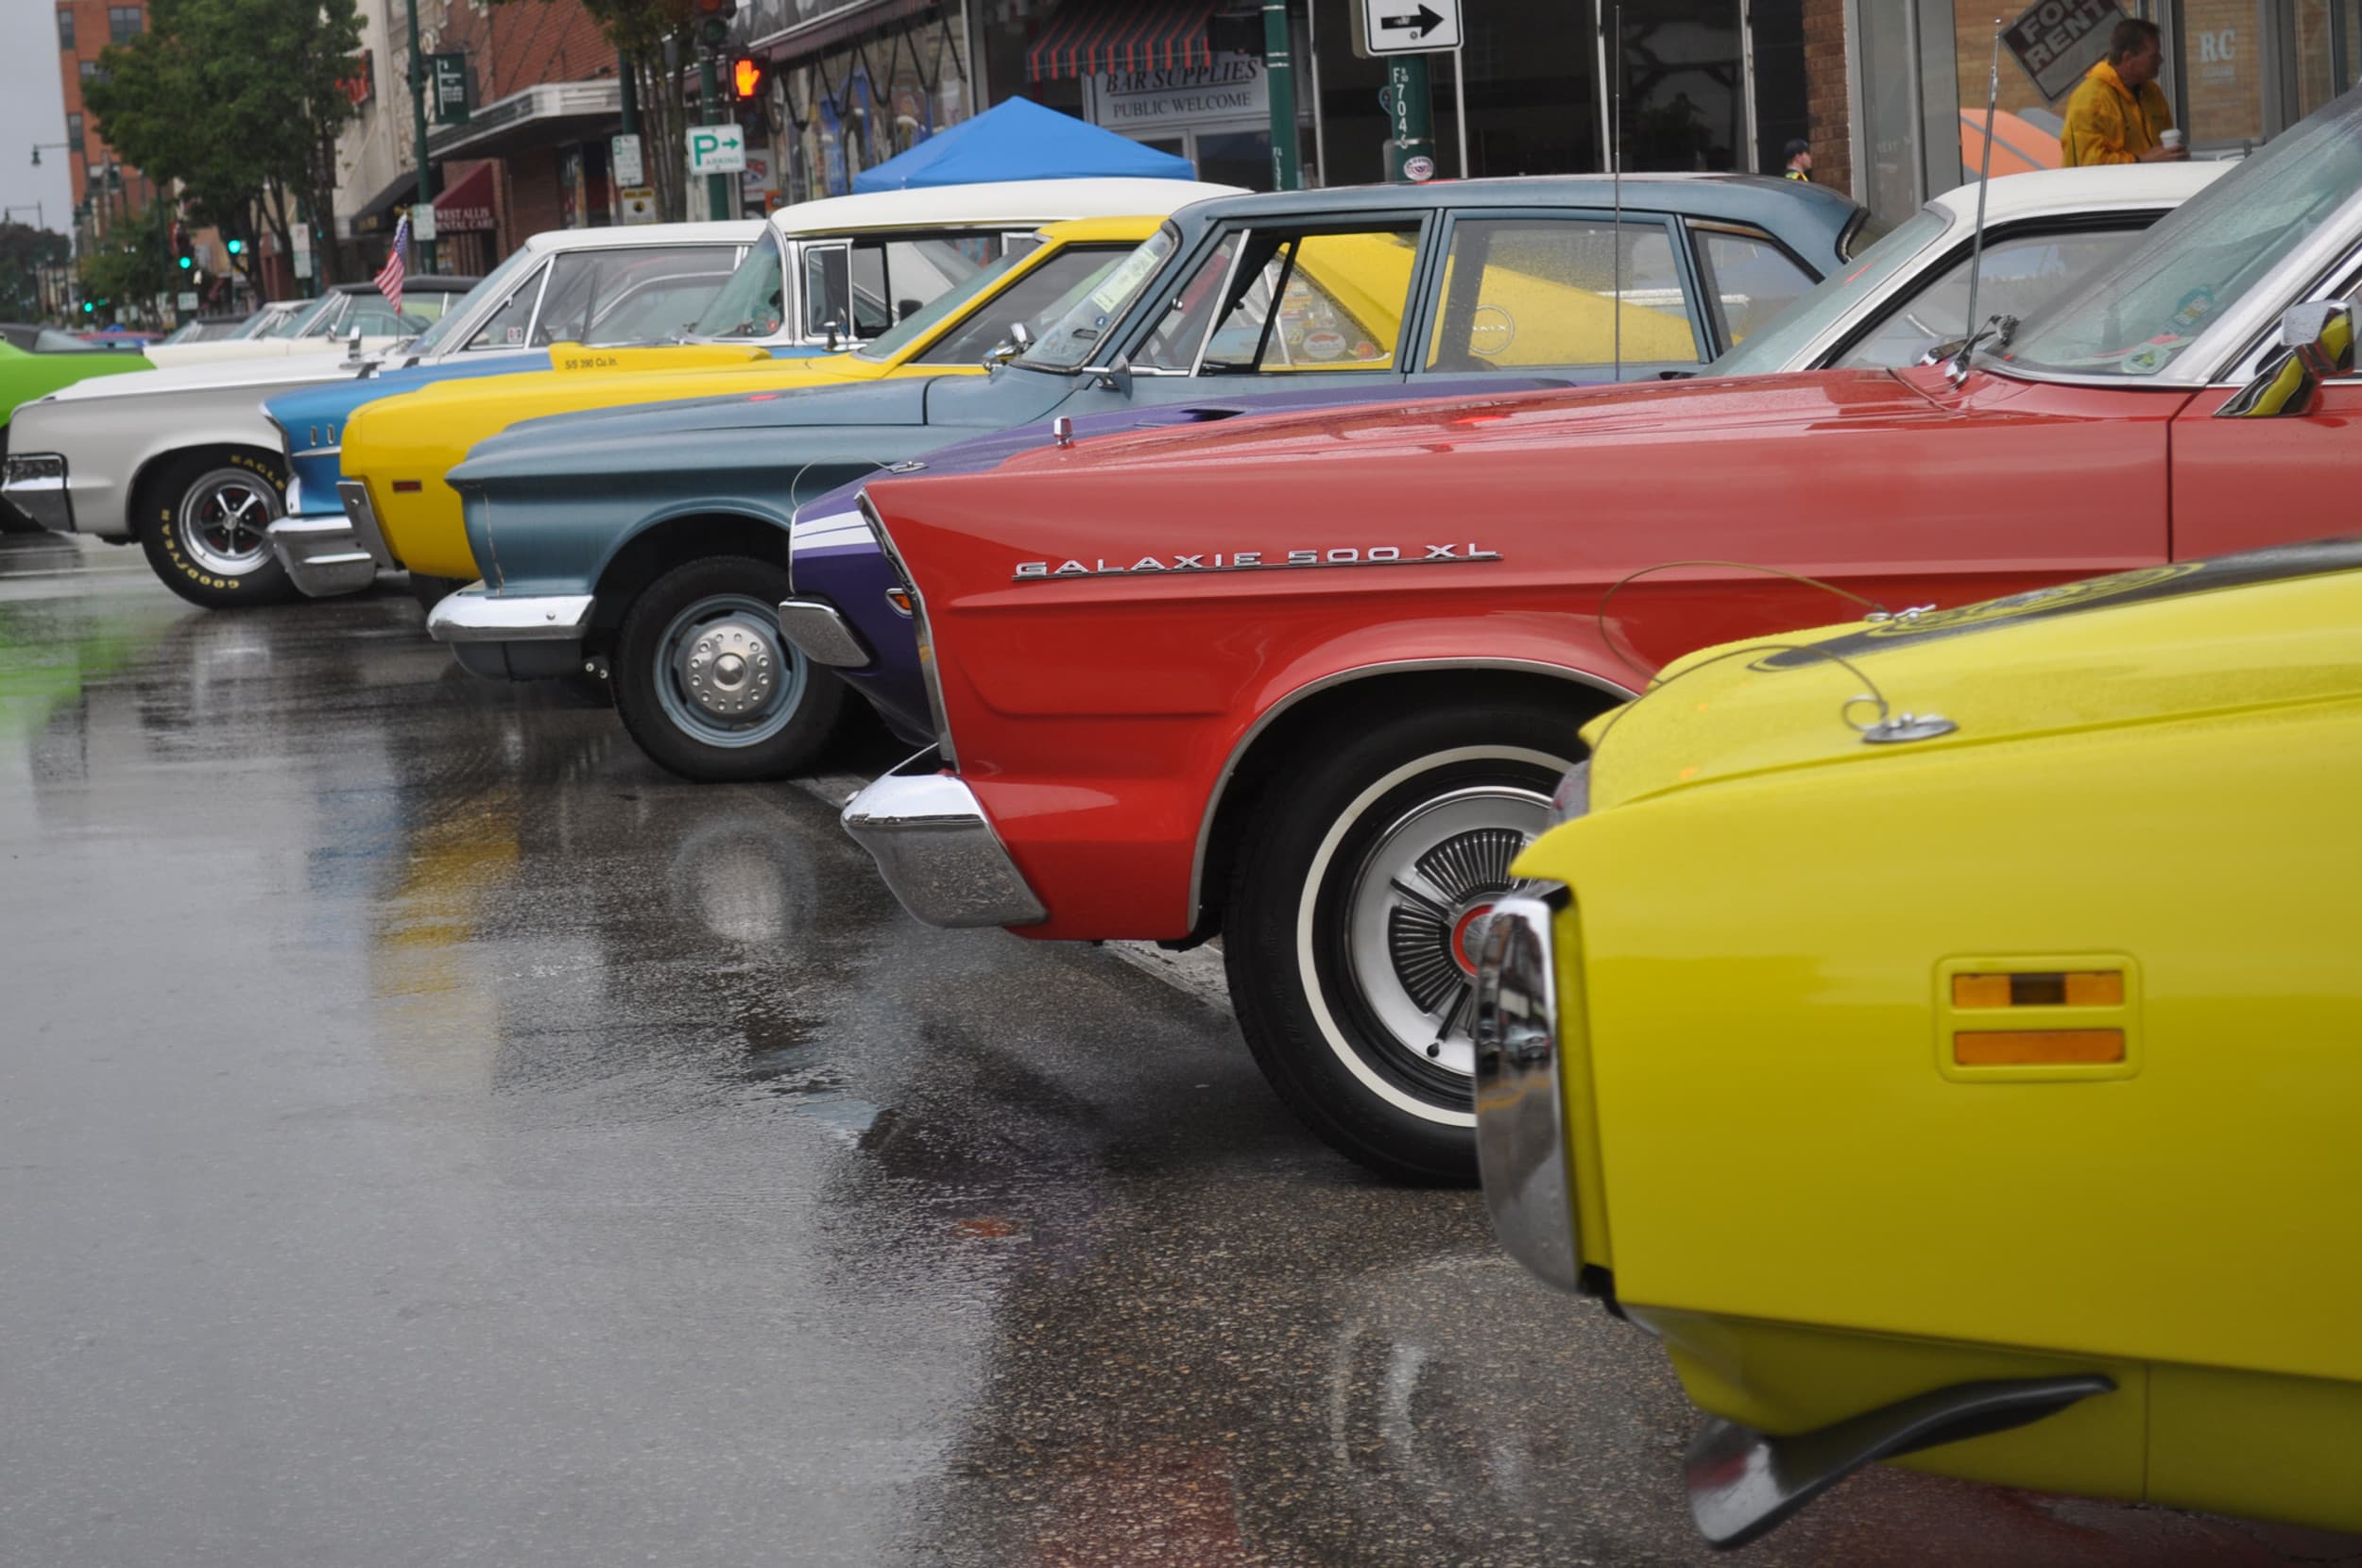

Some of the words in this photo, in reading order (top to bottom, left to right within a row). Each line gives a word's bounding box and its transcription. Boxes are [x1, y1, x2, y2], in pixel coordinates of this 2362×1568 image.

[2024, 0, 2105, 71] RENT
[2199, 28, 2237, 63] RC
[1106, 70, 1147, 93] BAR
[1152, 60, 1258, 90] SUPPLIES
[1113, 97, 1169, 118] PUBLIC
[1171, 92, 1253, 112] WELCOME
[436, 208, 461, 220] WEST
[463, 206, 490, 219] ALLIS
[231, 454, 284, 490] EAGLE
[161, 509, 240, 588] GOODYEAR
[1016, 552, 1261, 576] GALAXIE
[1288, 546, 1400, 564] 500
[1425, 543, 1497, 559] XL
